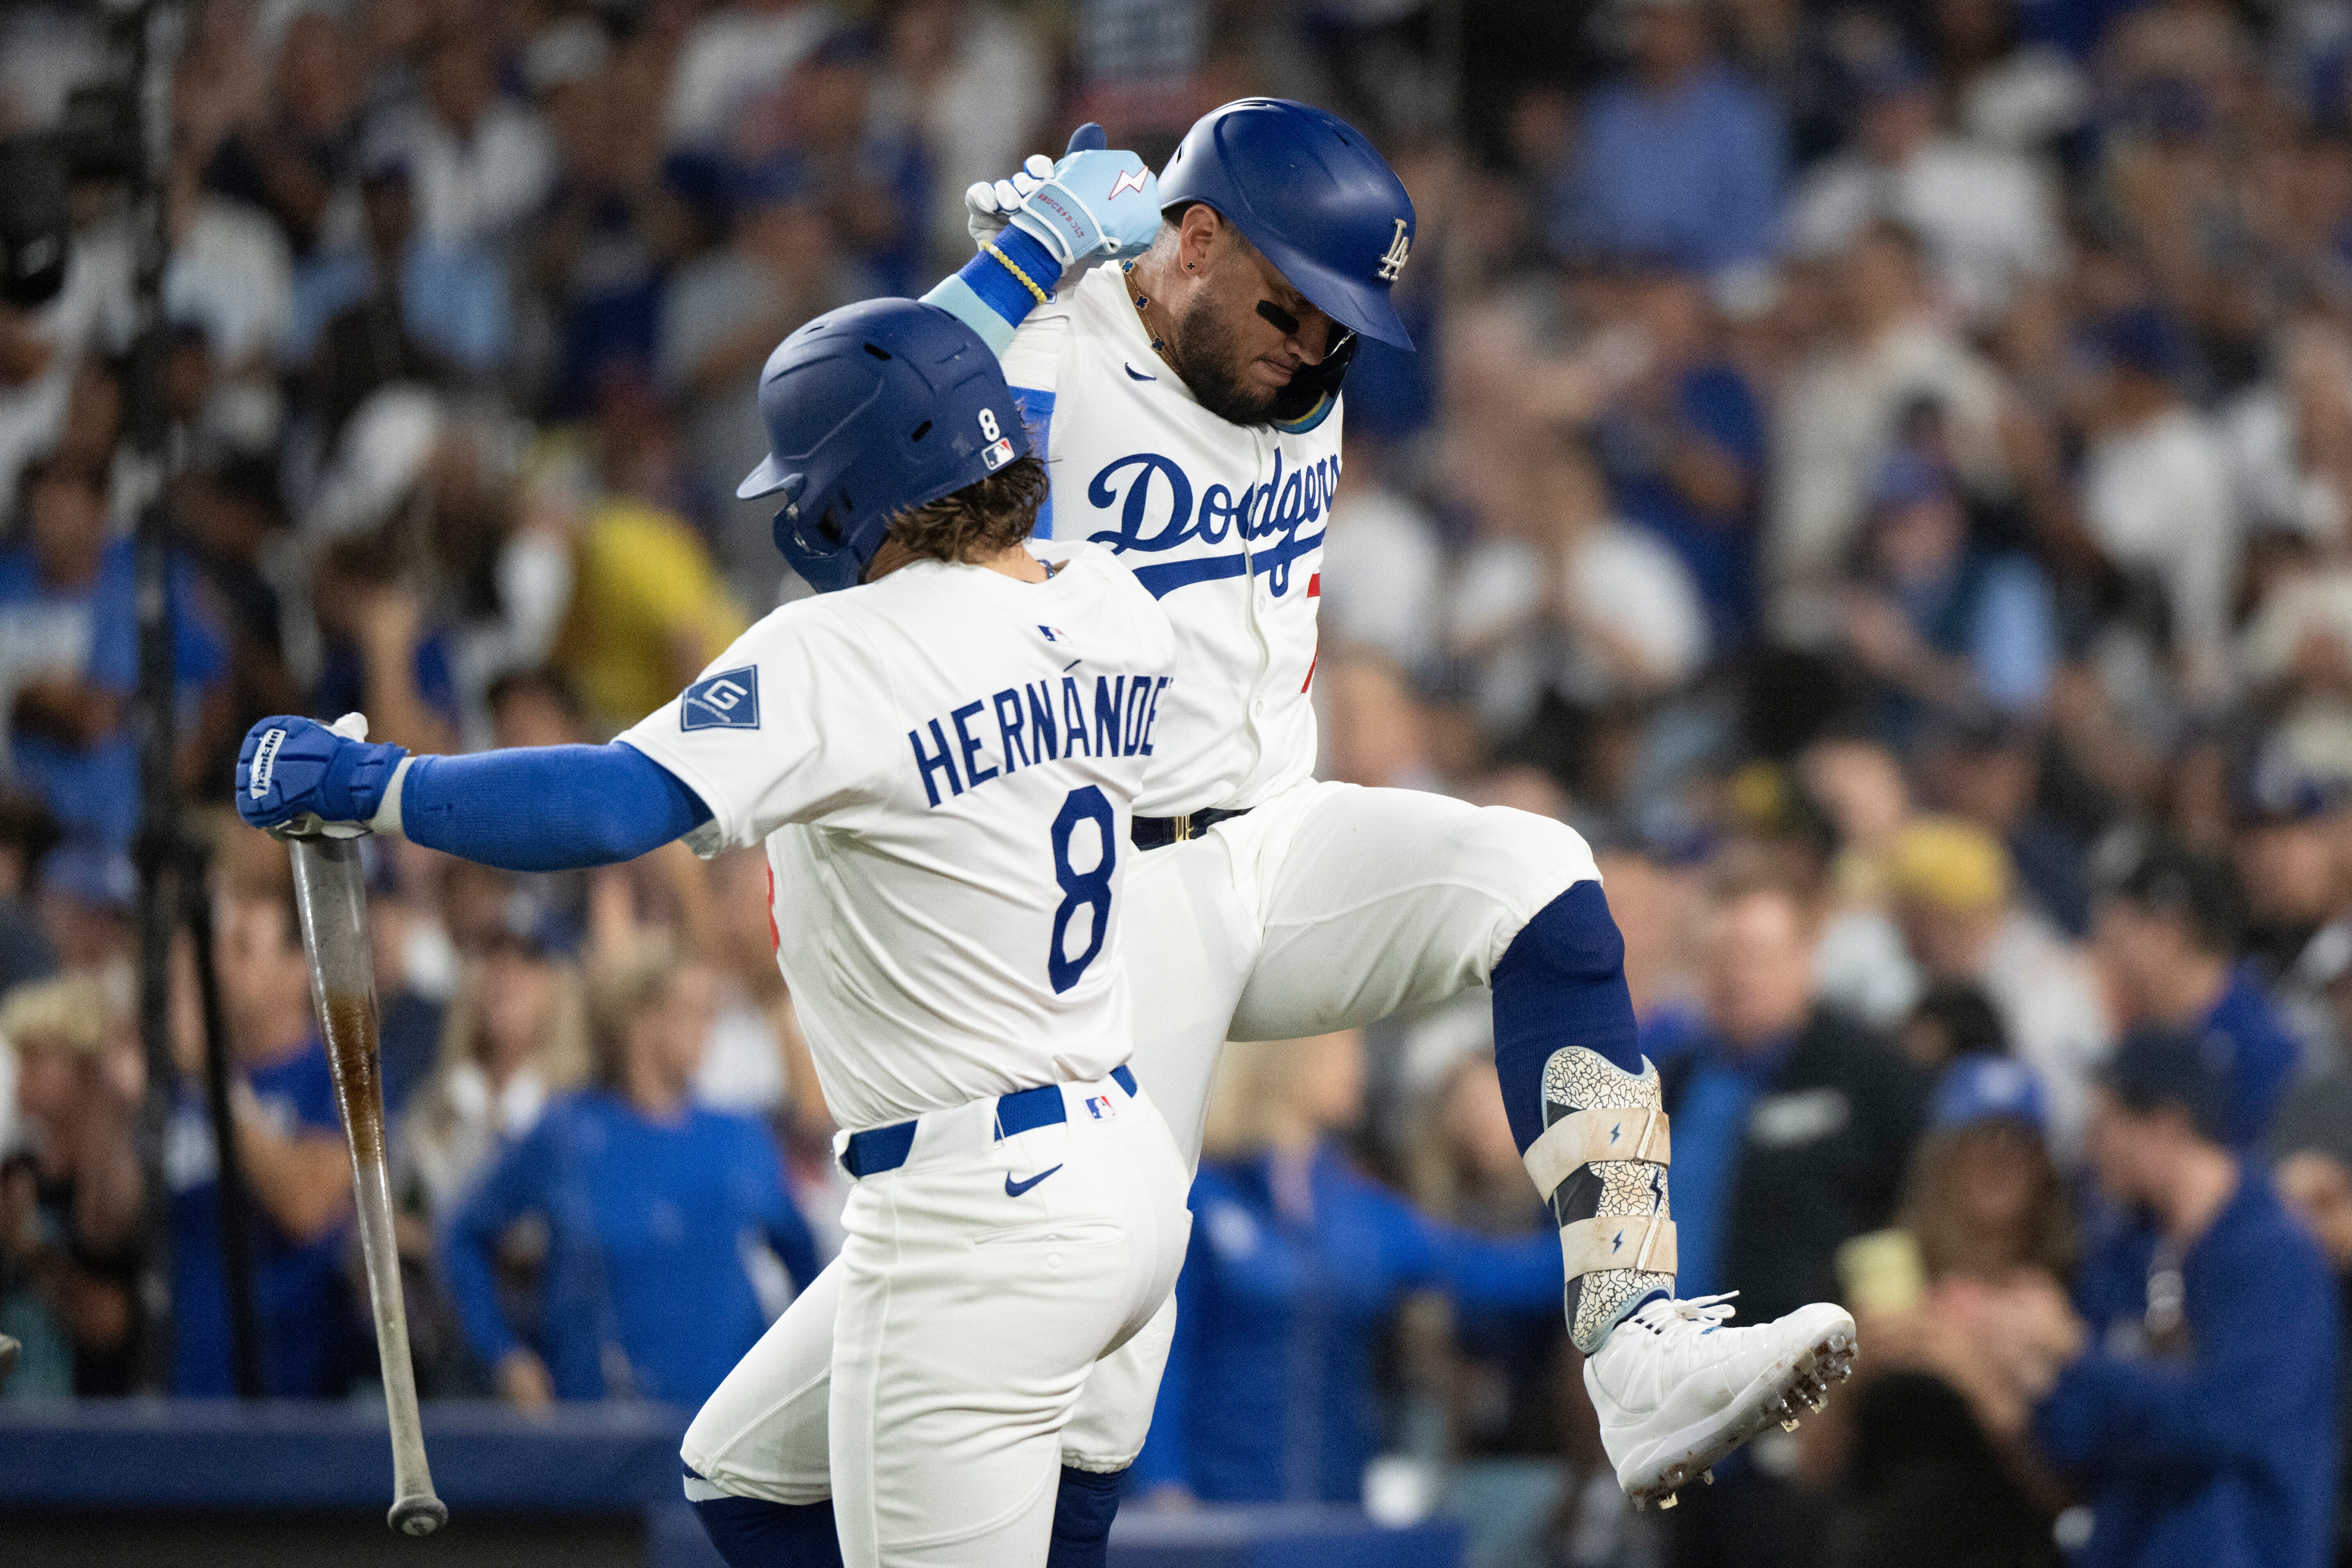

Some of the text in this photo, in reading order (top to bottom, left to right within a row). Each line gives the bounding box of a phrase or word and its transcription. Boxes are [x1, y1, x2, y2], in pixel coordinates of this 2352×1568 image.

[1378, 218, 1409, 281] LA
[978, 408, 1000, 442] 8
[908, 659, 1173, 808] HERNÁNDE
[1048, 785, 1116, 995] 8
